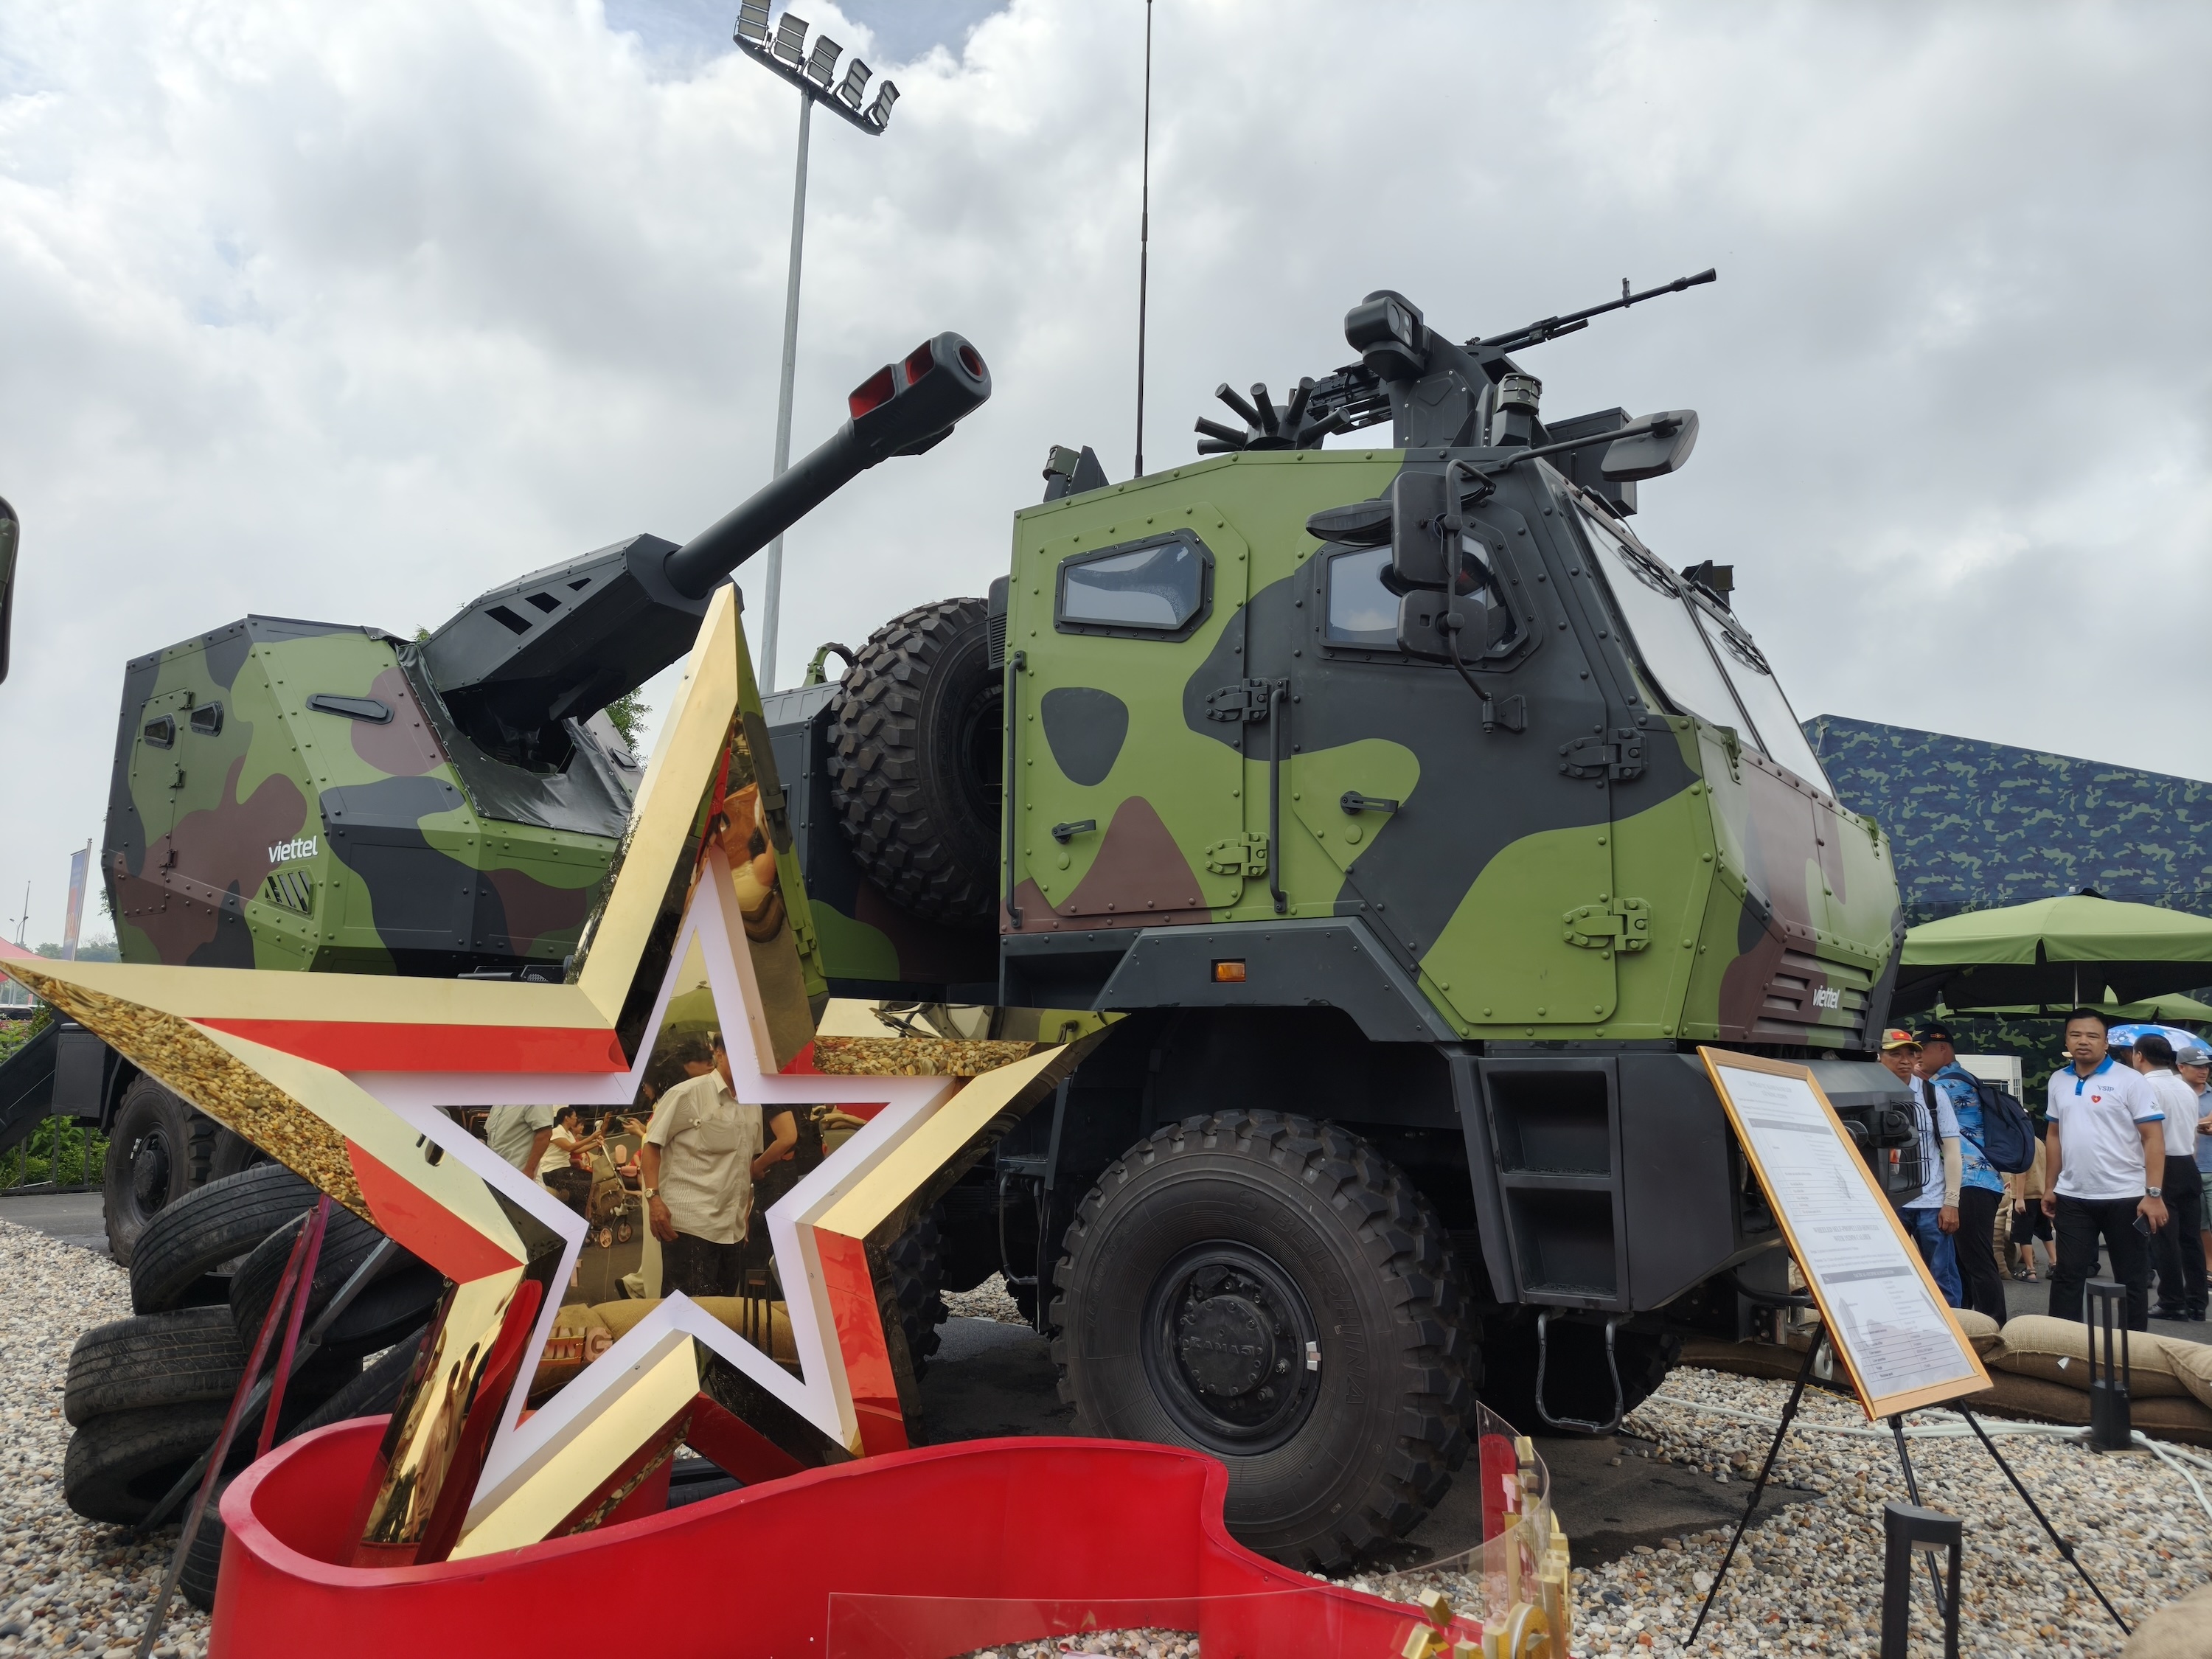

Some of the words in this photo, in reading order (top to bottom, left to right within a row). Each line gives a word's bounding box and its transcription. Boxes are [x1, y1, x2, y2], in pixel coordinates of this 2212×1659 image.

[268, 835, 318, 863] viettel
[1813, 985, 1840, 1009] viettel
[1270, 1208, 1368, 1405] BELSHINA
